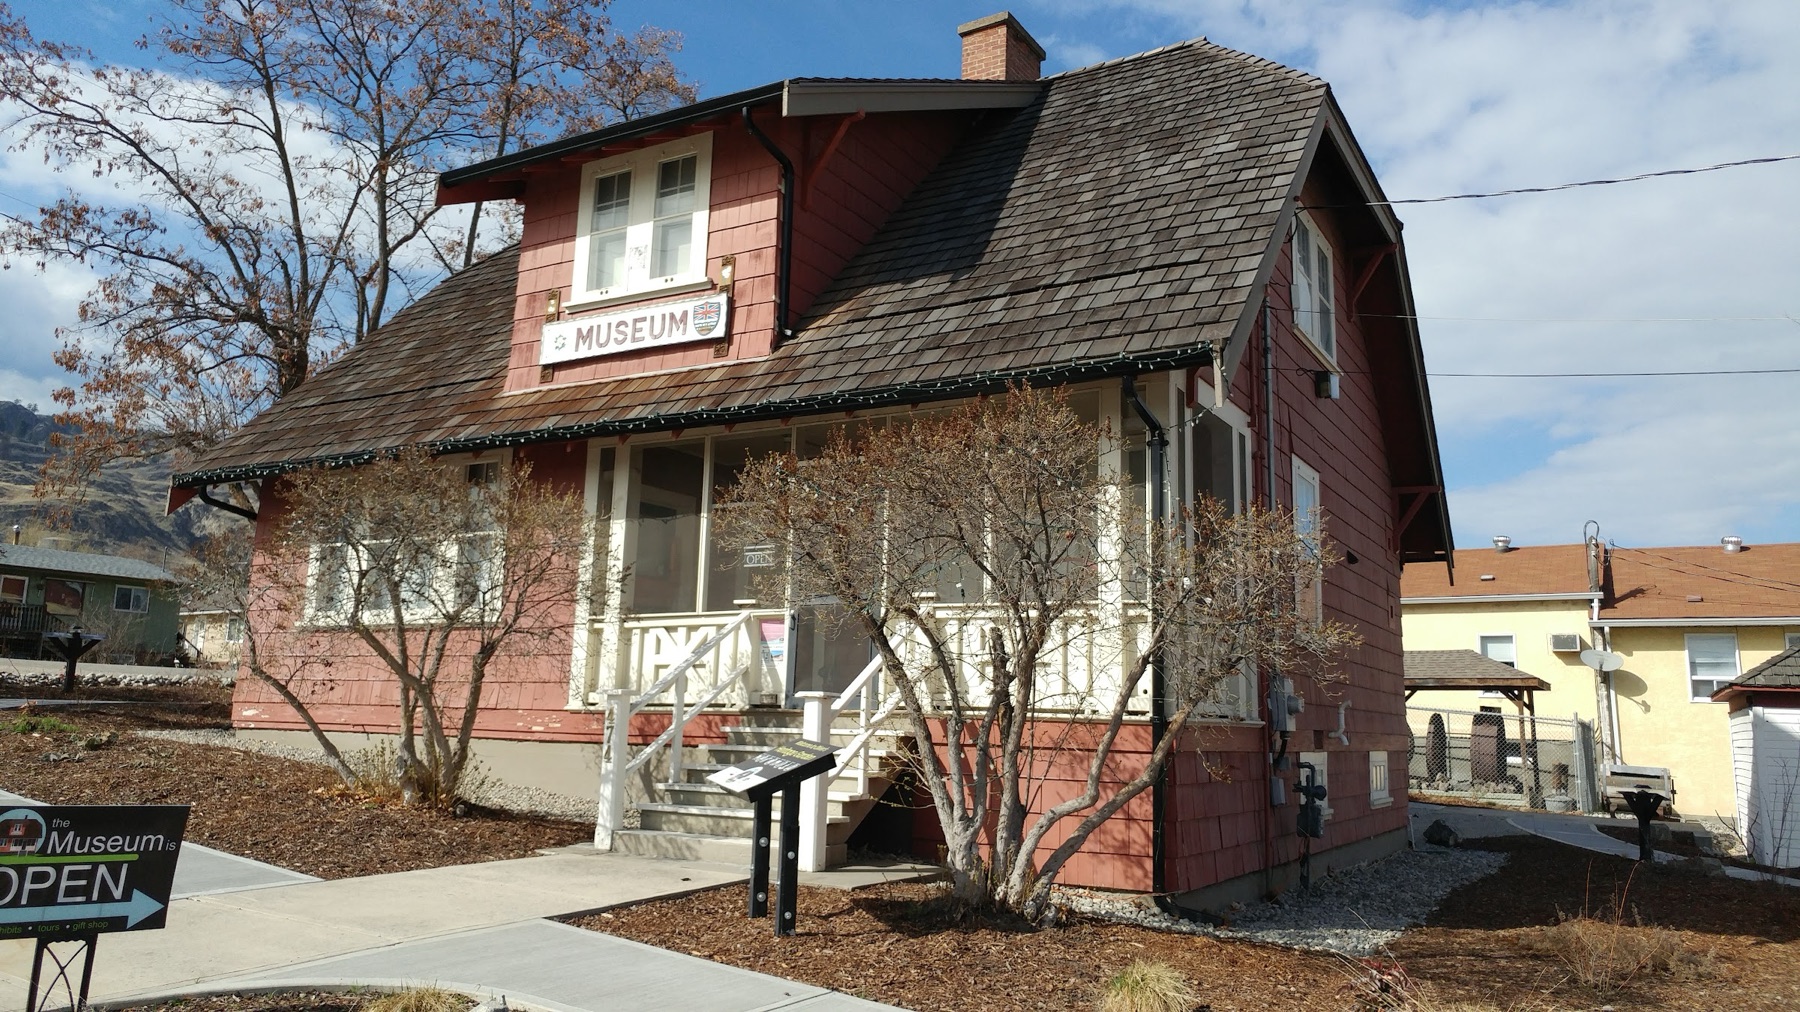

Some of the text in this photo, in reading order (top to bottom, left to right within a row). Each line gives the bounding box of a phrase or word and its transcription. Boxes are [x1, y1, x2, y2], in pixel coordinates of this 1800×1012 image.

[575, 309, 689, 352] MUSEUM
[746, 554, 773, 565] OPEN
[52, 818, 71, 828] the
[47, 831, 177, 854] Museum is
[38, 924, 60, 932] tours
[72, 922, 86, 931] gift
[88, 920, 108, 930] shop
